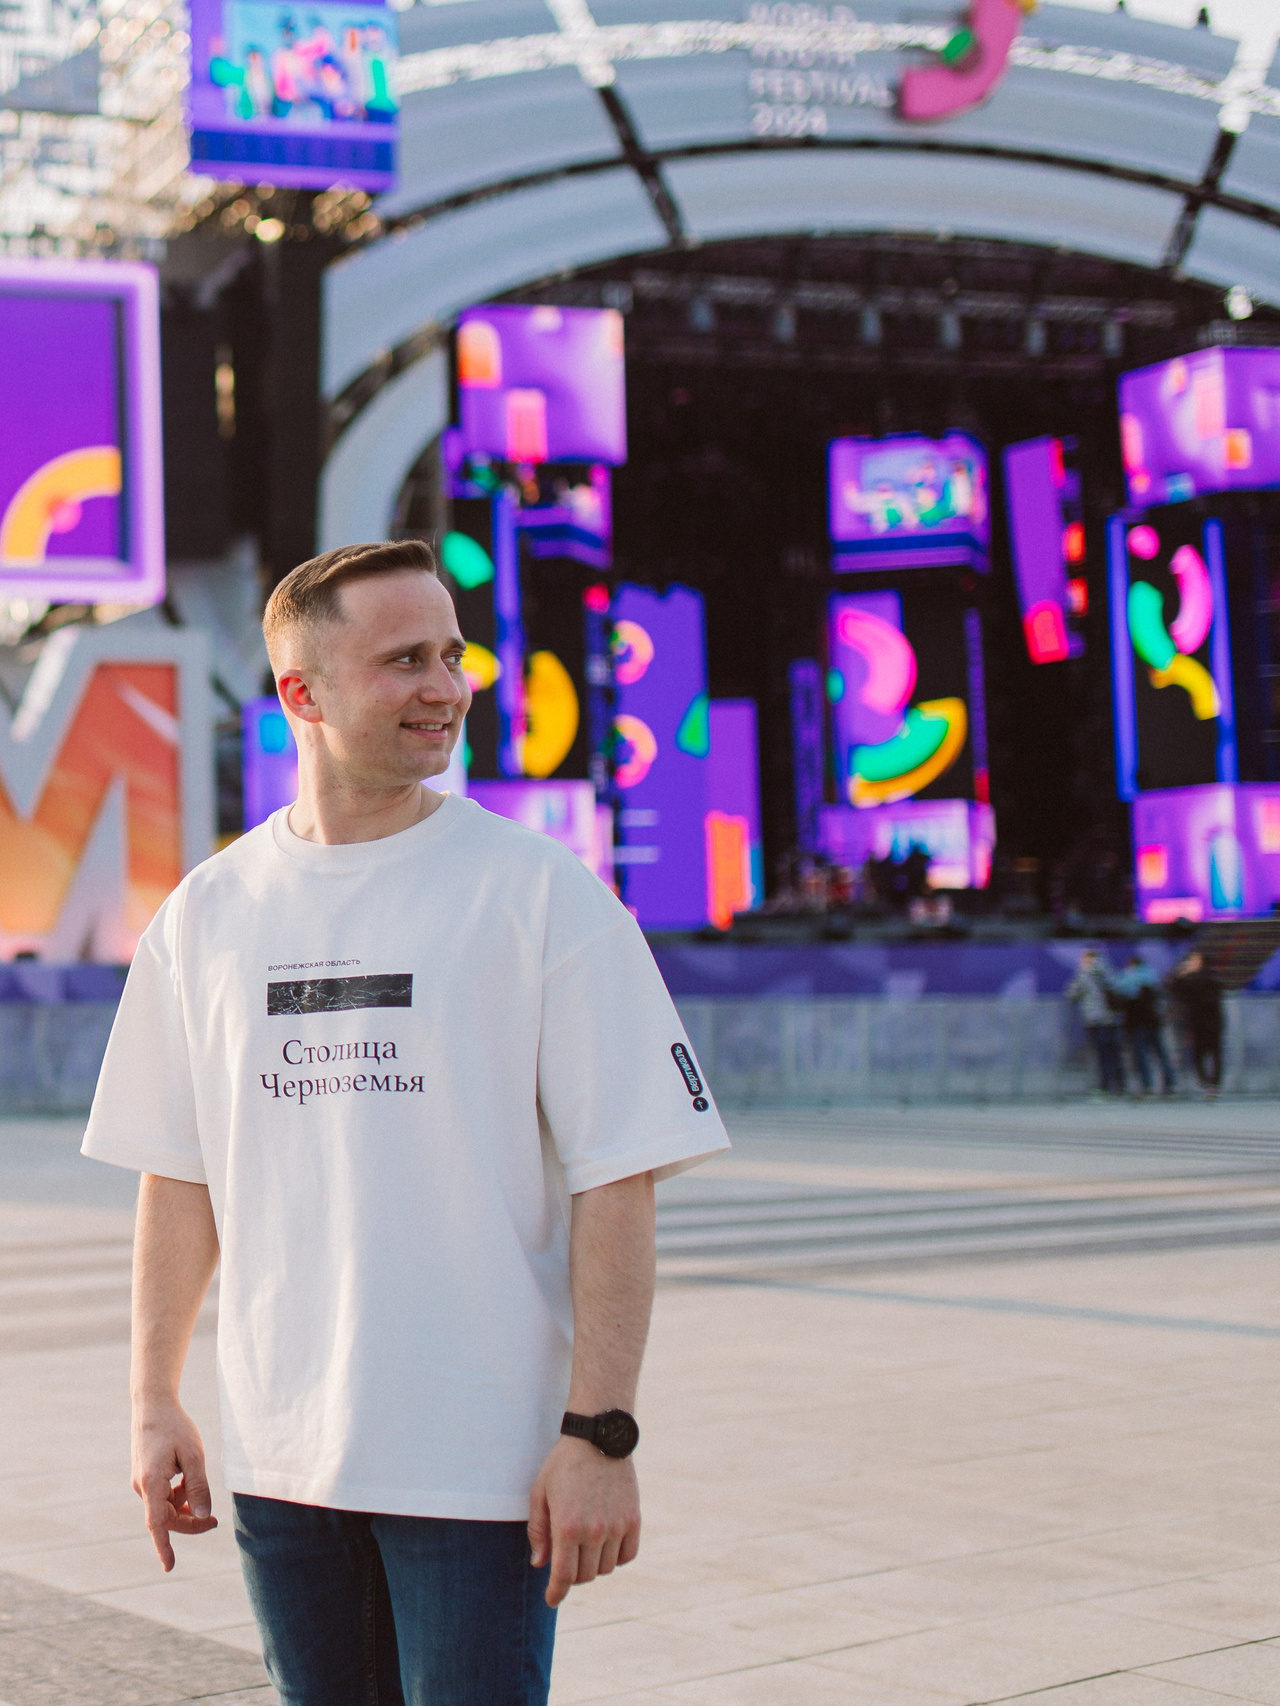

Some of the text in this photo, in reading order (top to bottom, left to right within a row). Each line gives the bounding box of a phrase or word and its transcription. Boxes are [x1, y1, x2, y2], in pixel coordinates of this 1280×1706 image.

[267, 959, 361, 972] ВОРОНЕЖСКАЯ ОБЛАСТЬ
[282, 1039, 399, 1065] Столица
[259, 1073, 426, 1106] Черноземья
